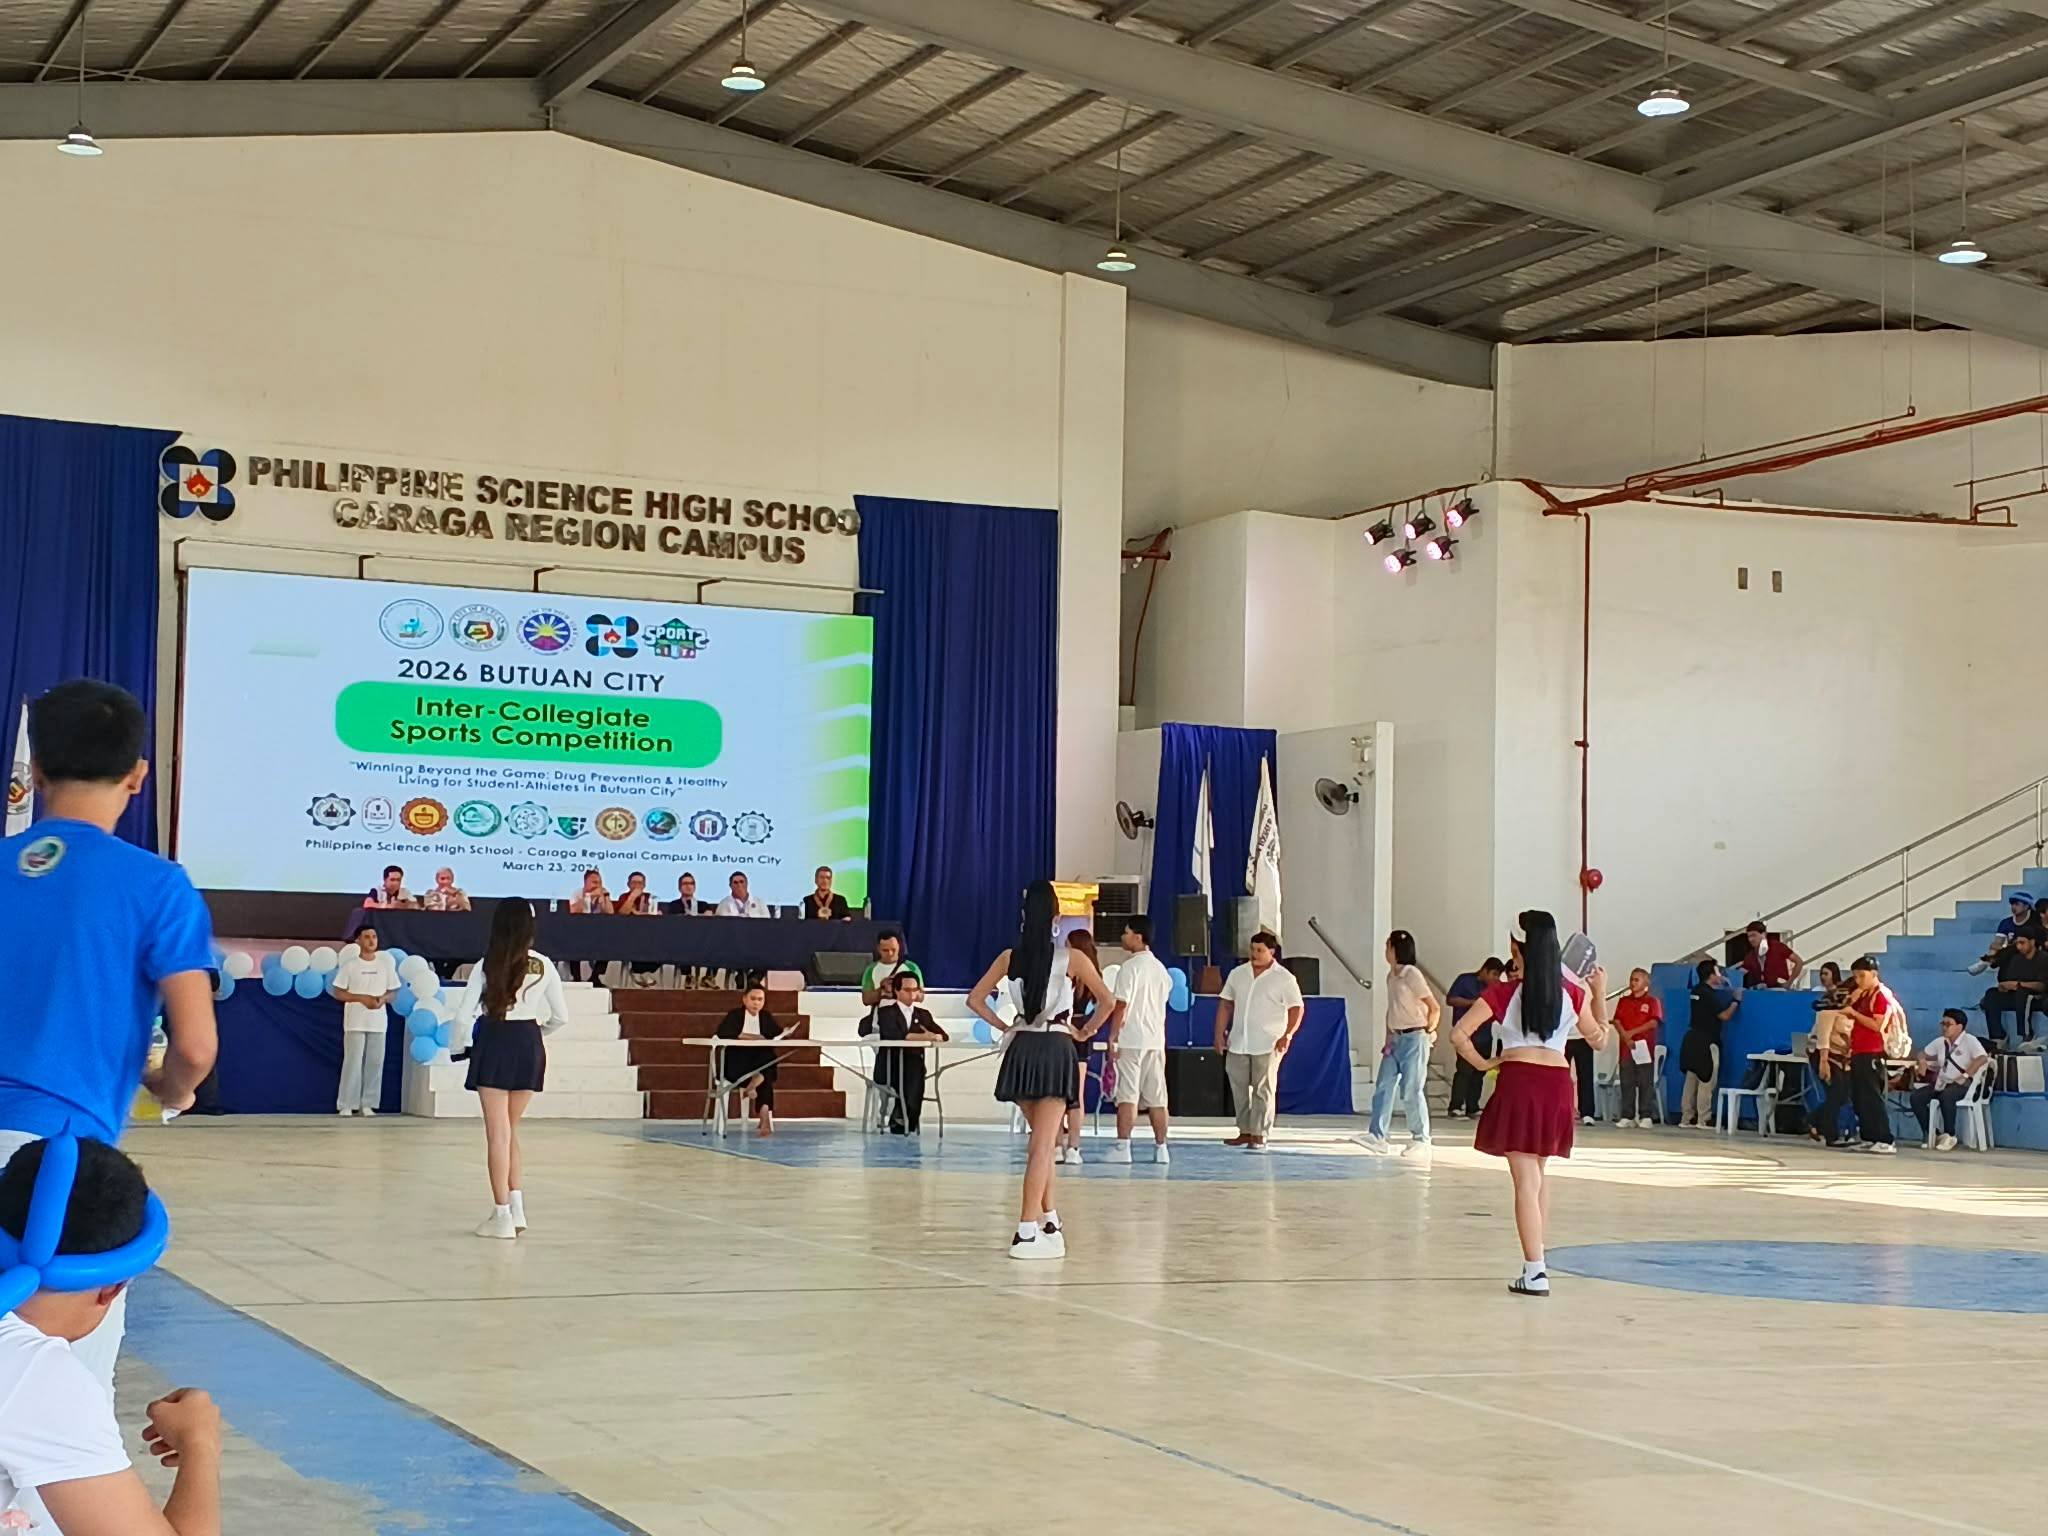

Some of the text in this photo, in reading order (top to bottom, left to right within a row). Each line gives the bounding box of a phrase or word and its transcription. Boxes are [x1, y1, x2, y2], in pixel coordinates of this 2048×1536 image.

[248, 456, 861, 537] PHILIPPINE SCIENCE HIGH SCHOO
[333, 498, 806, 564] CARAGA REGION CAMPUS
[398, 658, 665, 693] 2026 BUTUAN CITY
[415, 696, 650, 730] Inter-Collegiate
[390, 719, 674, 753] Sports Competition
[398, 775, 439, 788] Living
[443, 776, 462, 786] for
[467, 777, 579, 793] Student-Athletes
[584, 783, 595, 793] in
[600, 784, 646, 795] Butuan
[418, 764, 471, 777] Beyond
[475, 767, 498, 777] the
[502, 767, 549, 779] Game:
[554, 770, 586, 783] Drug
[590, 772, 661, 785] Prevention
[665, 776, 673, 785] &
[678, 777, 729, 788] Healthy
[305, 839, 372, 851] Philippine
[377, 841, 430, 853] Science
[435, 844, 465, 855] High
[470, 845, 514, 856] School
[527, 847, 577, 859] Caraga
[581, 849, 638, 860] Regional
[641, 850, 694, 862] Campus
[697, 853, 708, 862] in
[712, 853, 754, 864] Butuan
[757, 855, 782, 866] City
[502, 861, 544, 871] March
[548, 862, 566, 872] 23,
